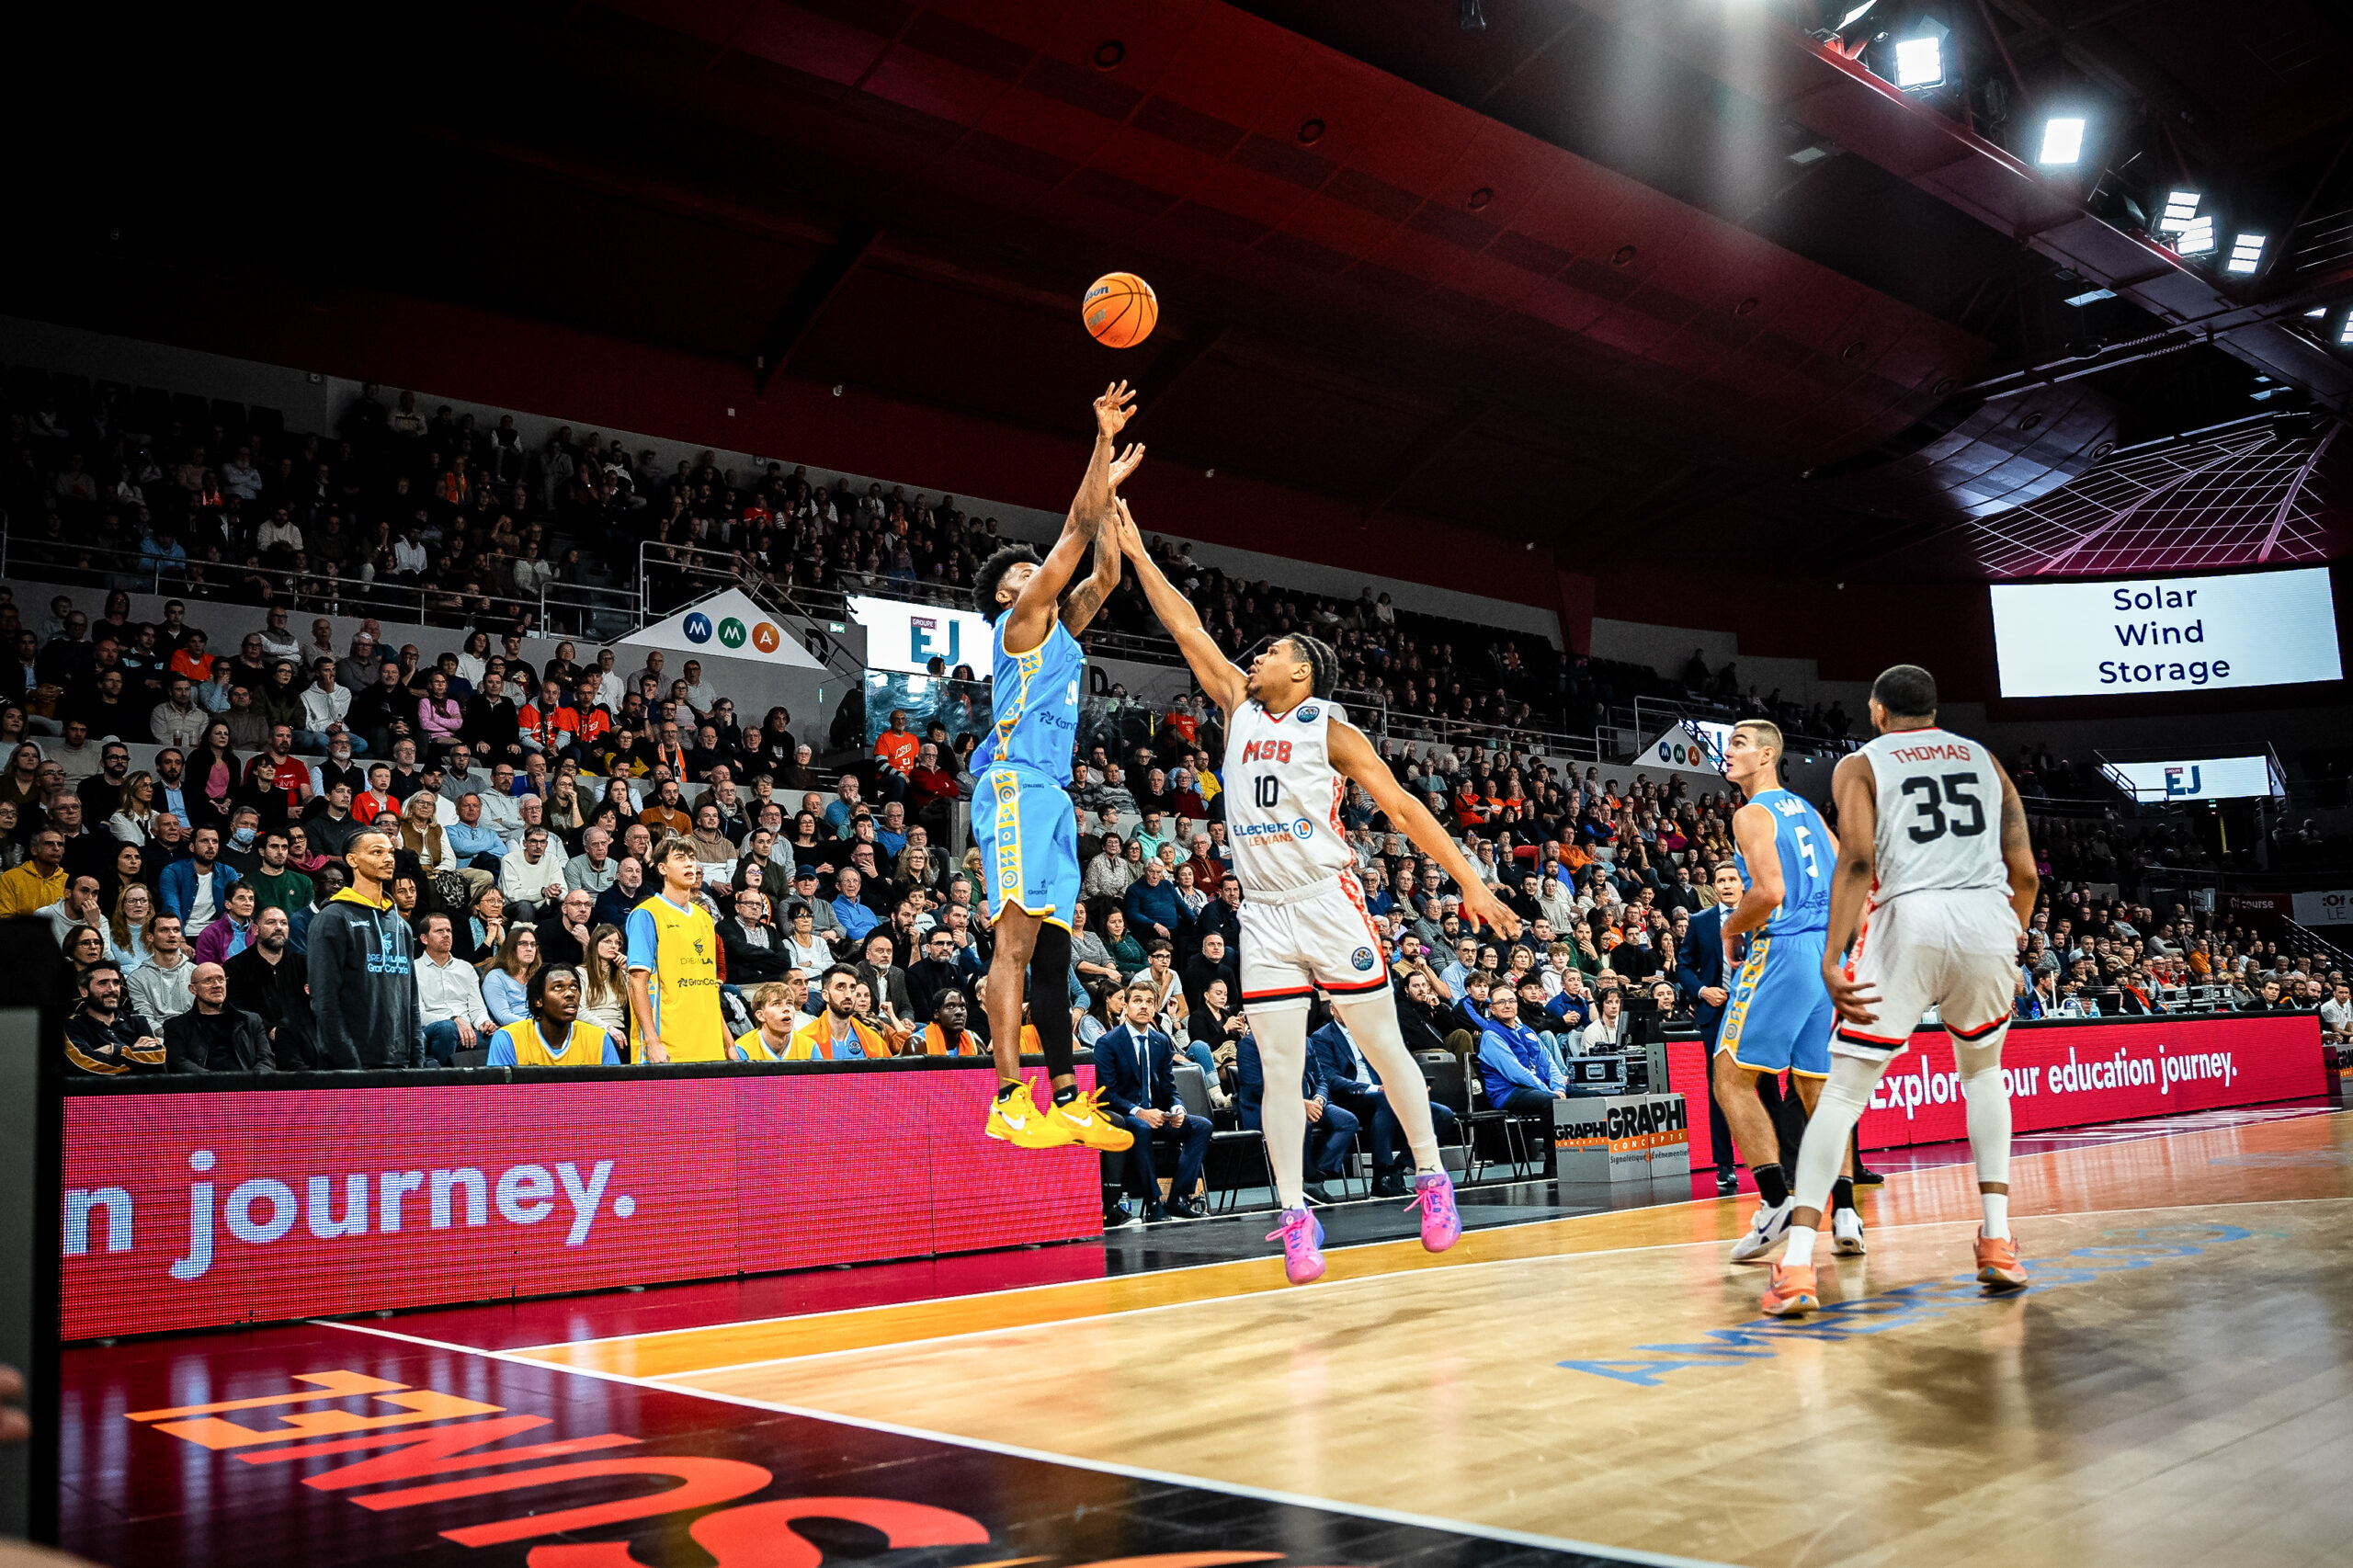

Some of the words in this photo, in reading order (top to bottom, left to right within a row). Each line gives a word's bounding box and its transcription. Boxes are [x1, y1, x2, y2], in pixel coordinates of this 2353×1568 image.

[1084, 287, 1108, 304] lson
[2113, 585, 2198, 611] Solar
[912, 618, 934, 628] GROUPE
[2114, 619, 2204, 646] Wind
[911, 619, 961, 666] EJ
[1089, 665, 1108, 697] D
[2098, 660, 2231, 685] Storage
[1243, 739, 1292, 764] MSB
[1889, 744, 1972, 764] THOMAS
[1254, 774, 1279, 808] 10
[2165, 765, 2202, 796] EJ
[1901, 772, 1987, 844] 35
[1793, 825, 1819, 879] 5
[2001, 1065, 2040, 1099] our
[2048, 1046, 2156, 1094] education
[2158, 1044, 2238, 1096] journey.
[1553, 1120, 1608, 1142] GRAPHI
[1607, 1097, 1688, 1142] GRAPHI
[1613, 1132, 1683, 1152] CONCEPTS
[170, 1149, 637, 1280] journey.
